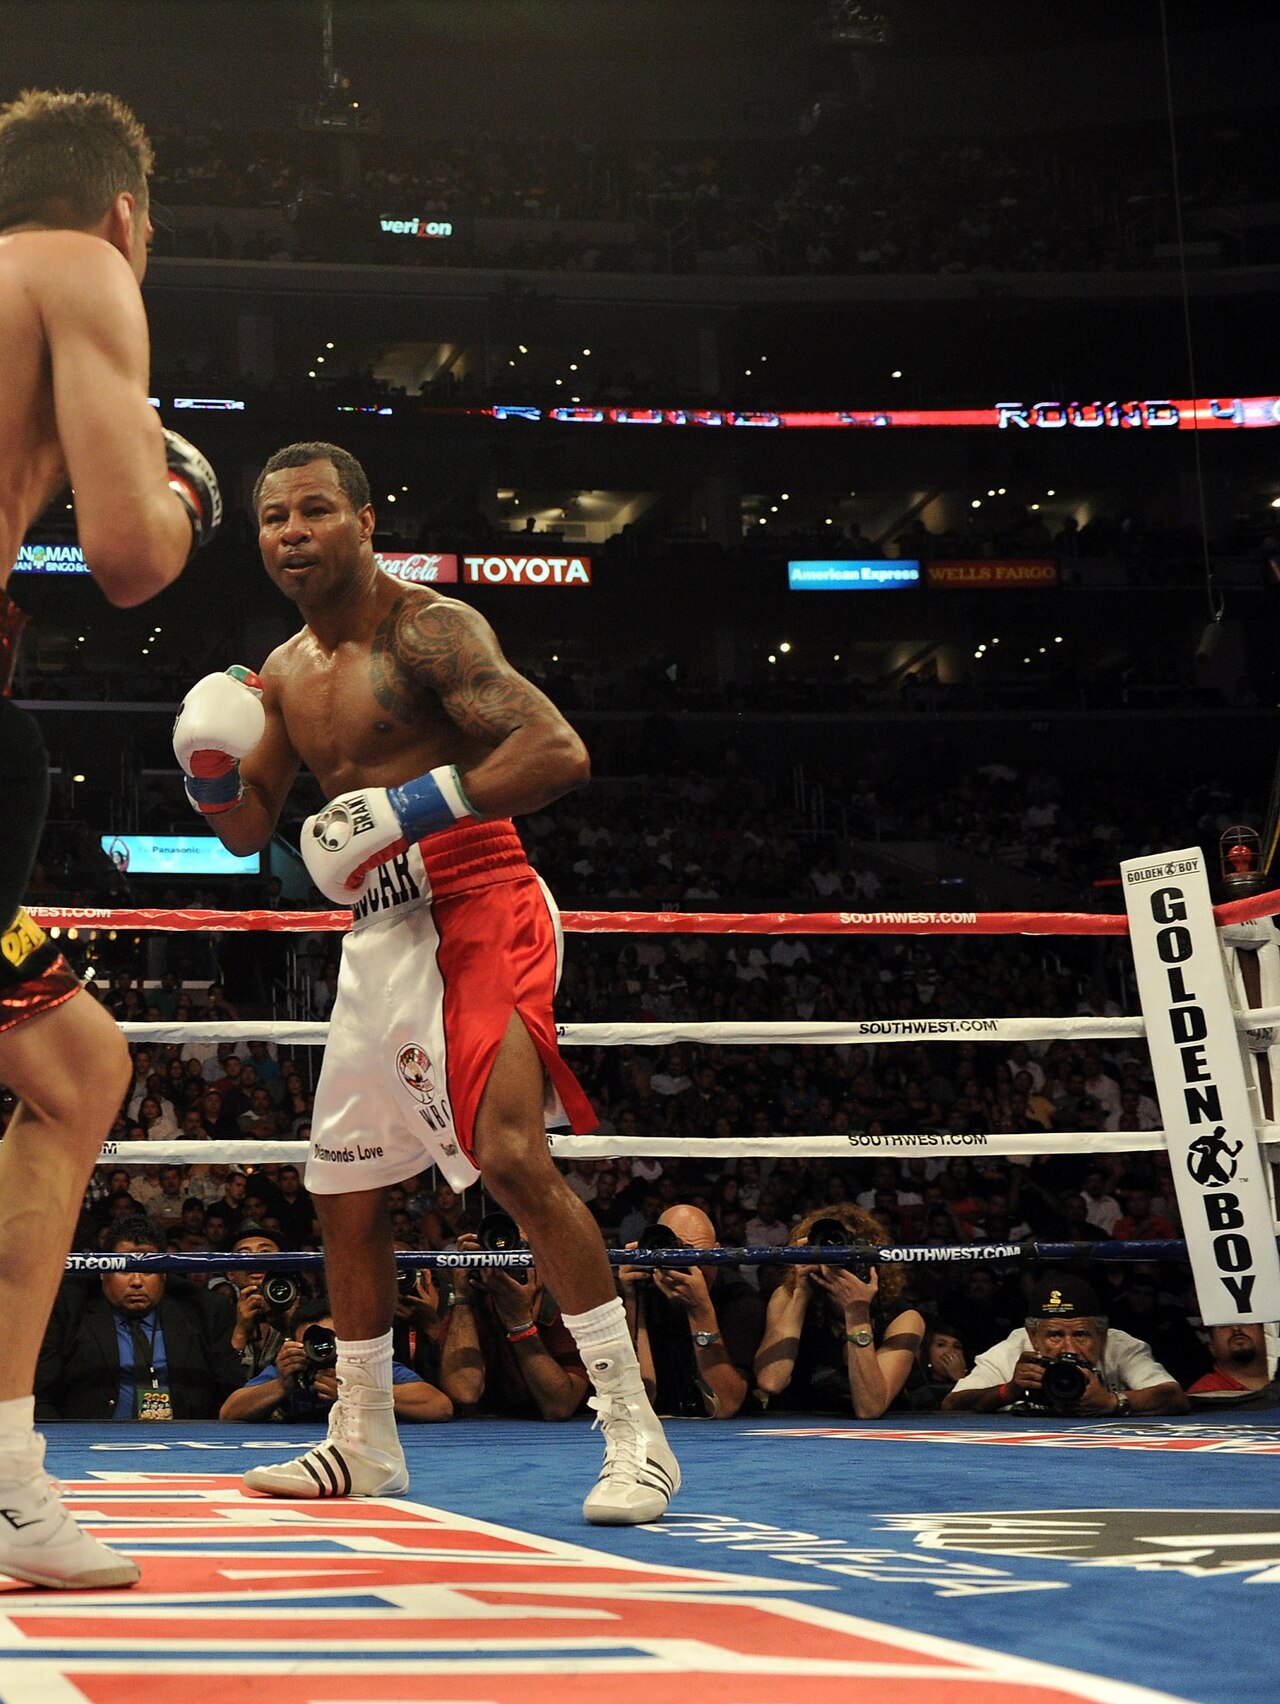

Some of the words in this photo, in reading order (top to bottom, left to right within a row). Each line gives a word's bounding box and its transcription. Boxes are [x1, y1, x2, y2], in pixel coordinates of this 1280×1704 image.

[380, 217, 452, 238] verizon
[995, 401, 1179, 428] ROUND
[46, 546, 86, 563] MAN
[464, 557, 590, 583] TOYOTA
[791, 568, 859, 581] American
[861, 567, 919, 583] Express
[928, 567, 991, 581] WELLS
[996, 565, 1057, 582] FARGO
[152, 846, 200, 854] Panasonic
[1127, 867, 1164, 884] GOLDEN
[1178, 860, 1200, 874] BOY
[839, 912, 977, 924] SOUTHWEST.COM
[859, 1020, 998, 1035] SOUTHWEST.COM
[1150, 886, 1224, 1125] GOLDEN
[1203, 1192, 1257, 1314] BOY
[848, 1134, 988, 1146] SOUTHWEST.COM
[357, 1144, 384, 1161] Love
[879, 1246, 1021, 1262] SOUTHWEST.COM
